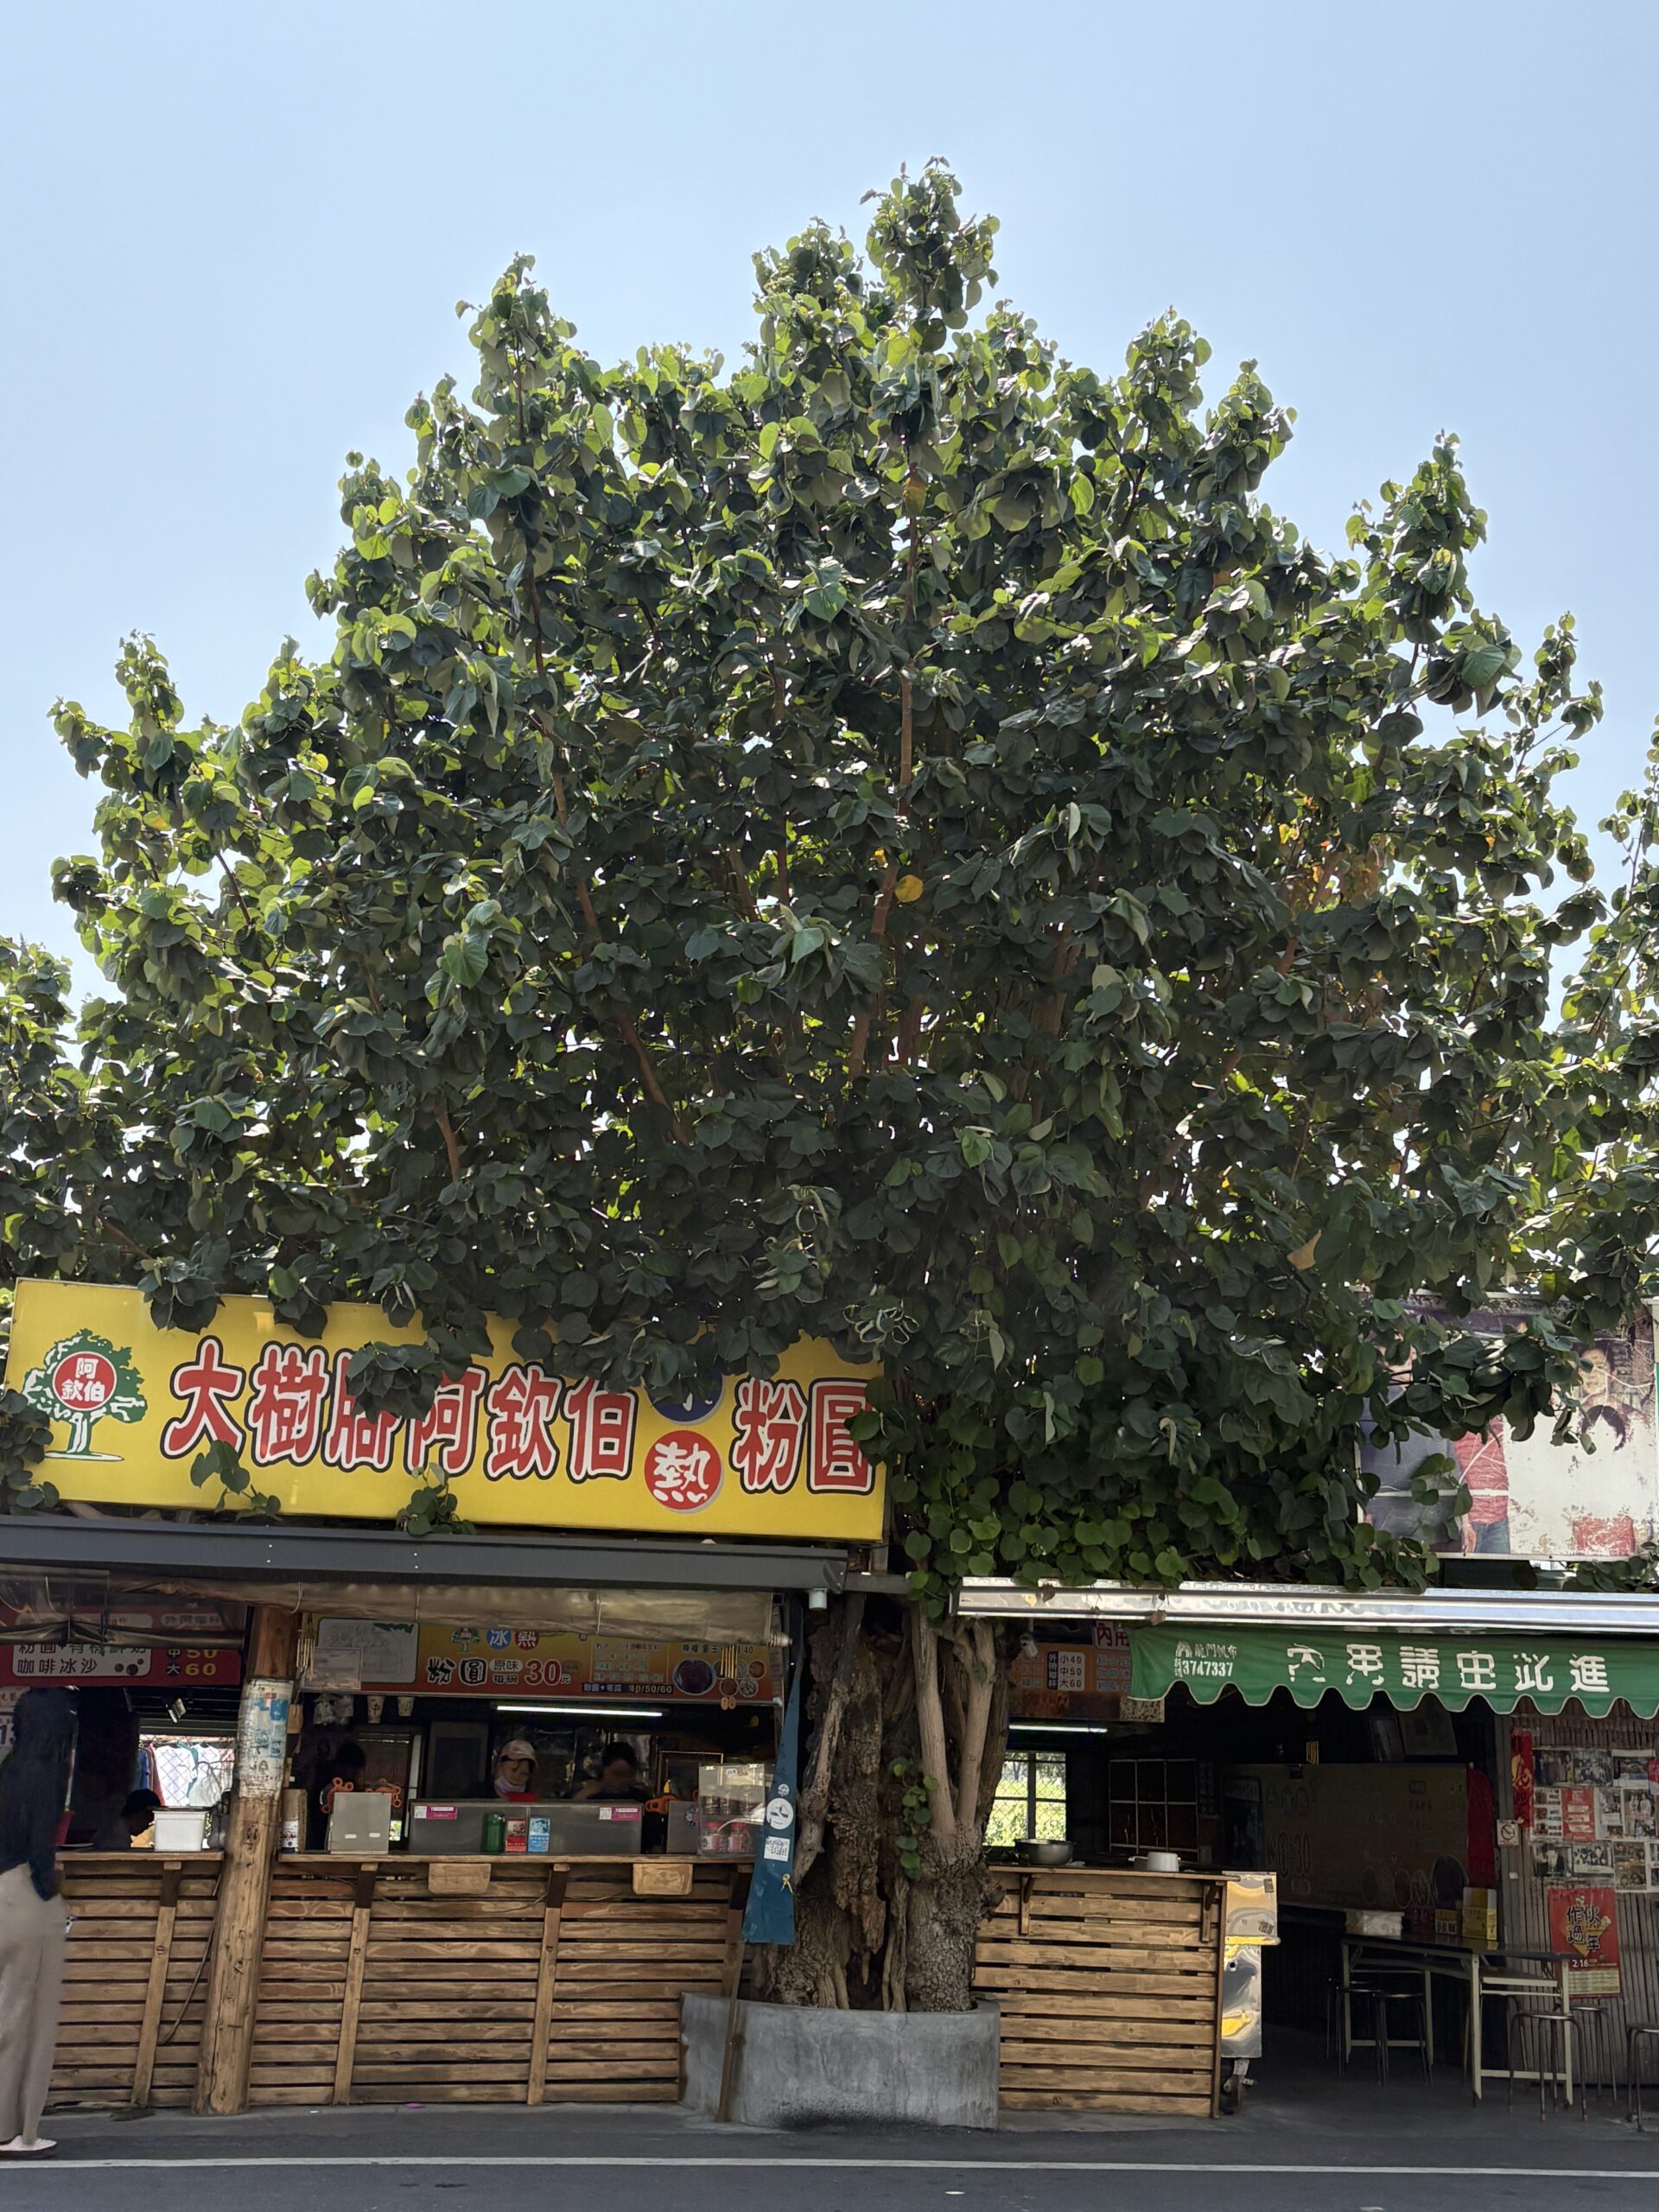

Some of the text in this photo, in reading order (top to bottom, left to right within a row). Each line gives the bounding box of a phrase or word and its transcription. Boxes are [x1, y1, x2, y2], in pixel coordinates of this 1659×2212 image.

[75, 1357, 99, 1379] 阿
[61, 1379, 105, 1402] 欽伯
[730, 1376, 875, 1495] 粉圓
[653, 1441, 710, 1502] 熱
[489, 1629, 509, 1646] 冰
[17, 1658, 98, 1674] 咖啡冰沙
[167, 1663, 217, 1675] 大 60
[427, 1657, 488, 1685] 粉圓
[493, 1659, 519, 1671] 原味
[524, 1659, 571, 1685] 30元
[1182, 1660, 1234, 1676] 3747337
[1567, 1904, 1600, 1925] 作伙
[1567, 1925, 1600, 1952] 過年
